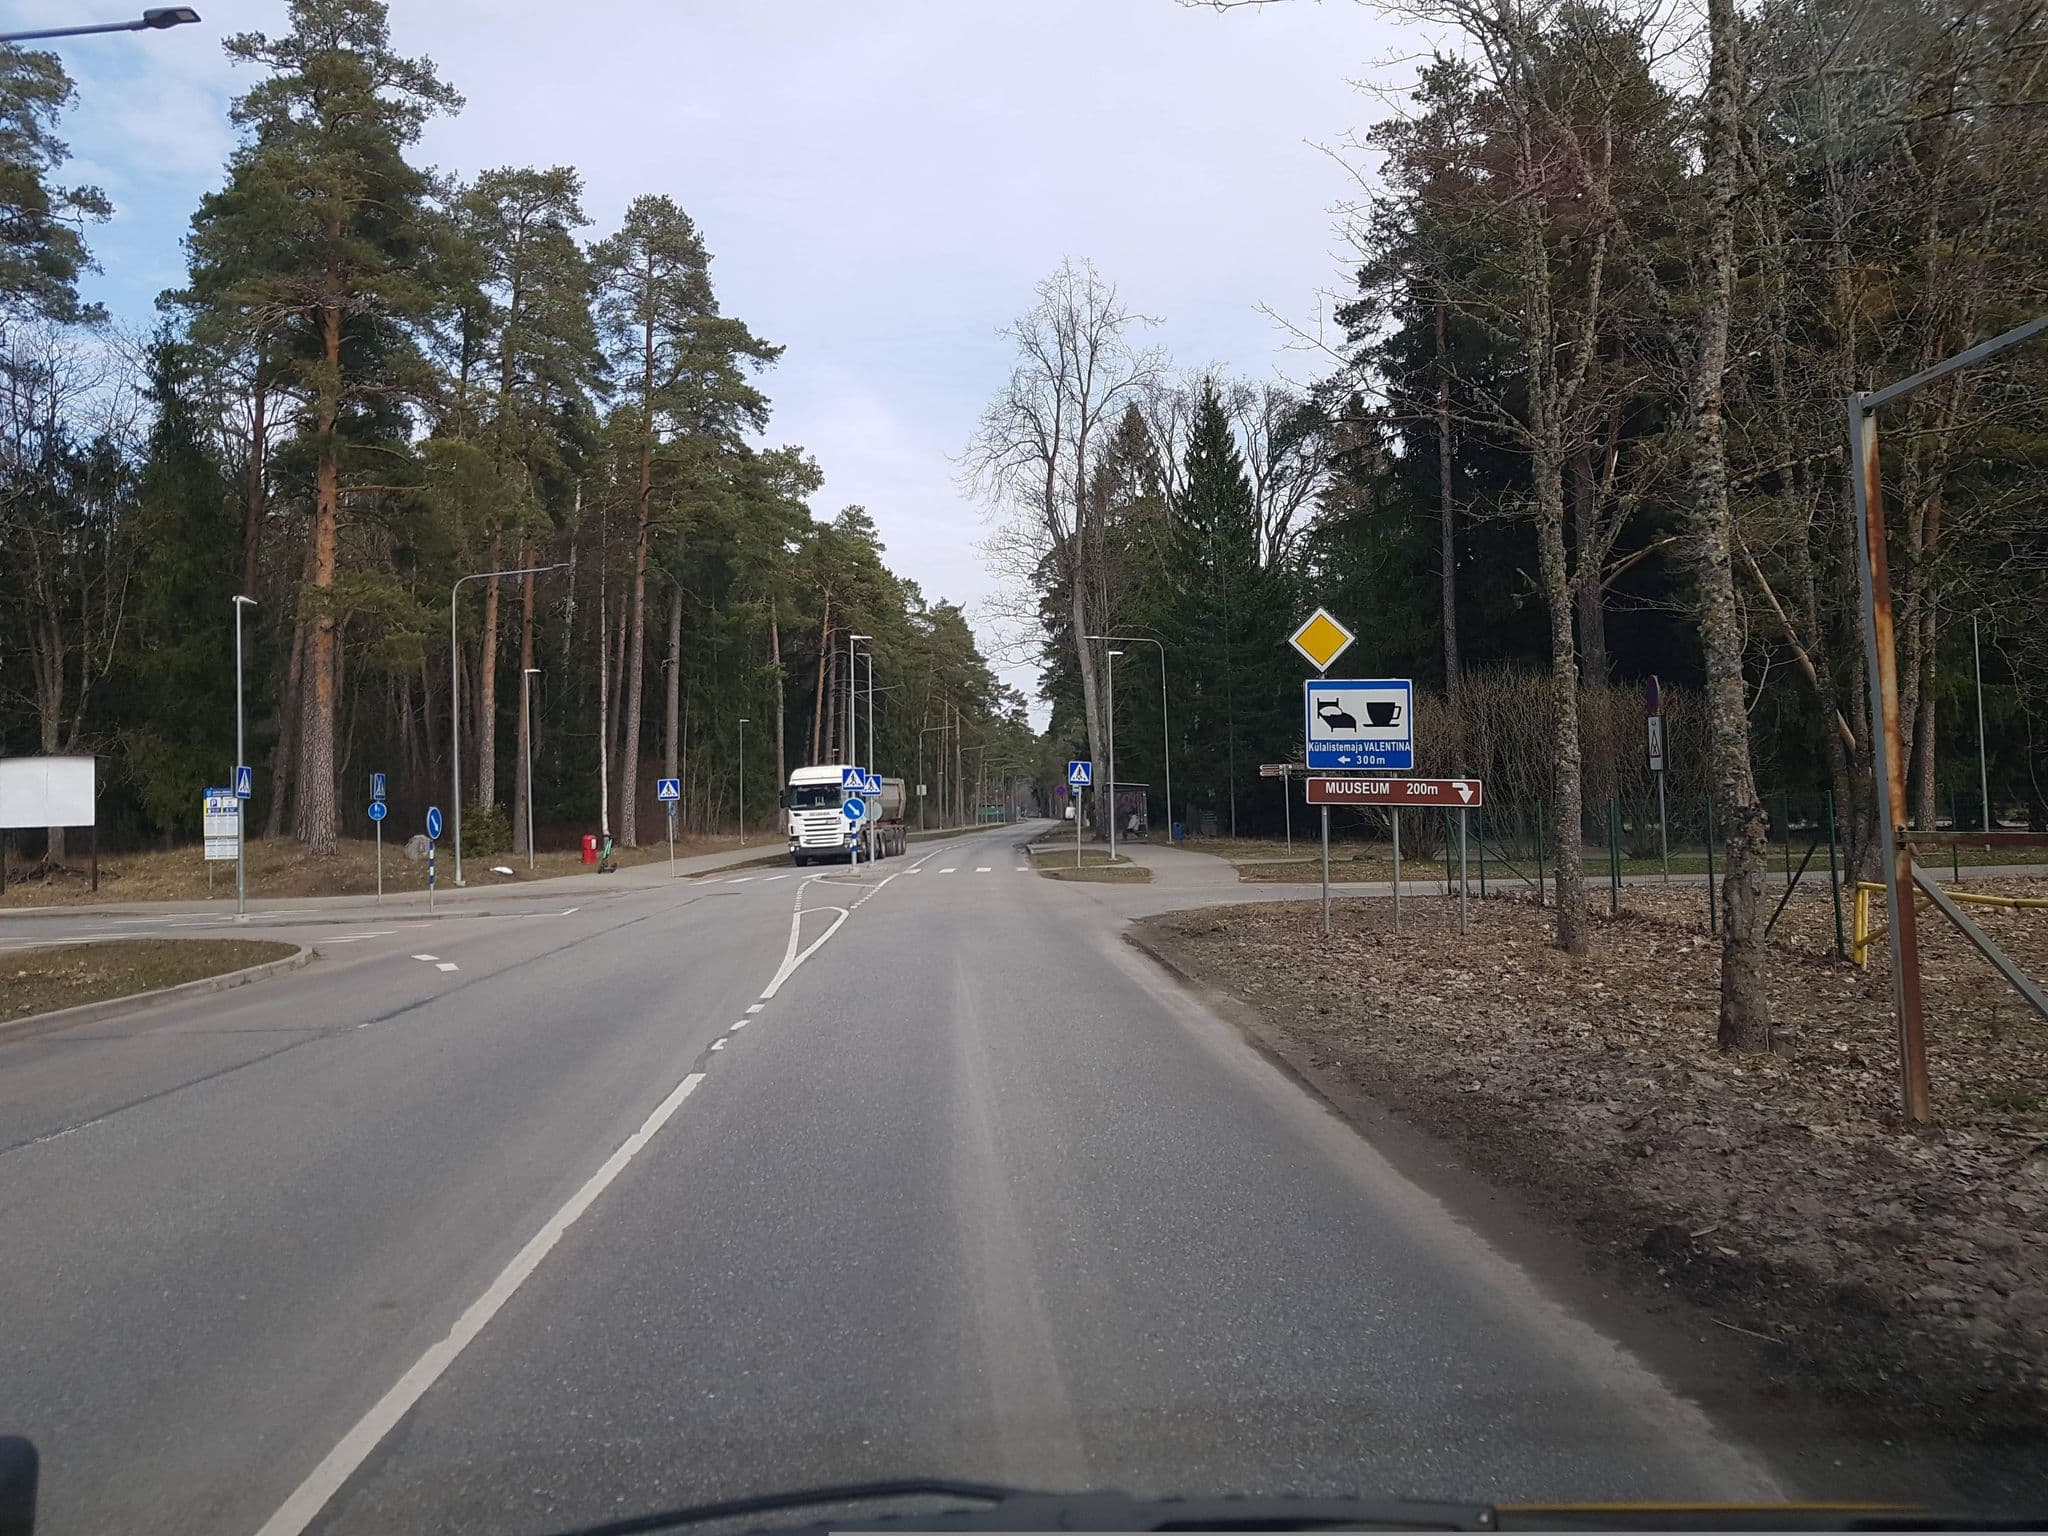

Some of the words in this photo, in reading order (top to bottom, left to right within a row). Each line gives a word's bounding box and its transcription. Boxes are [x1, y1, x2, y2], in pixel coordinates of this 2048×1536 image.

[1309, 742, 1363, 753] Külalistemaja
[1364, 742, 1410, 751] VALENTINA
[1326, 783, 1389, 794] MUUSEUM
[1407, 784, 1438, 795] 200m
